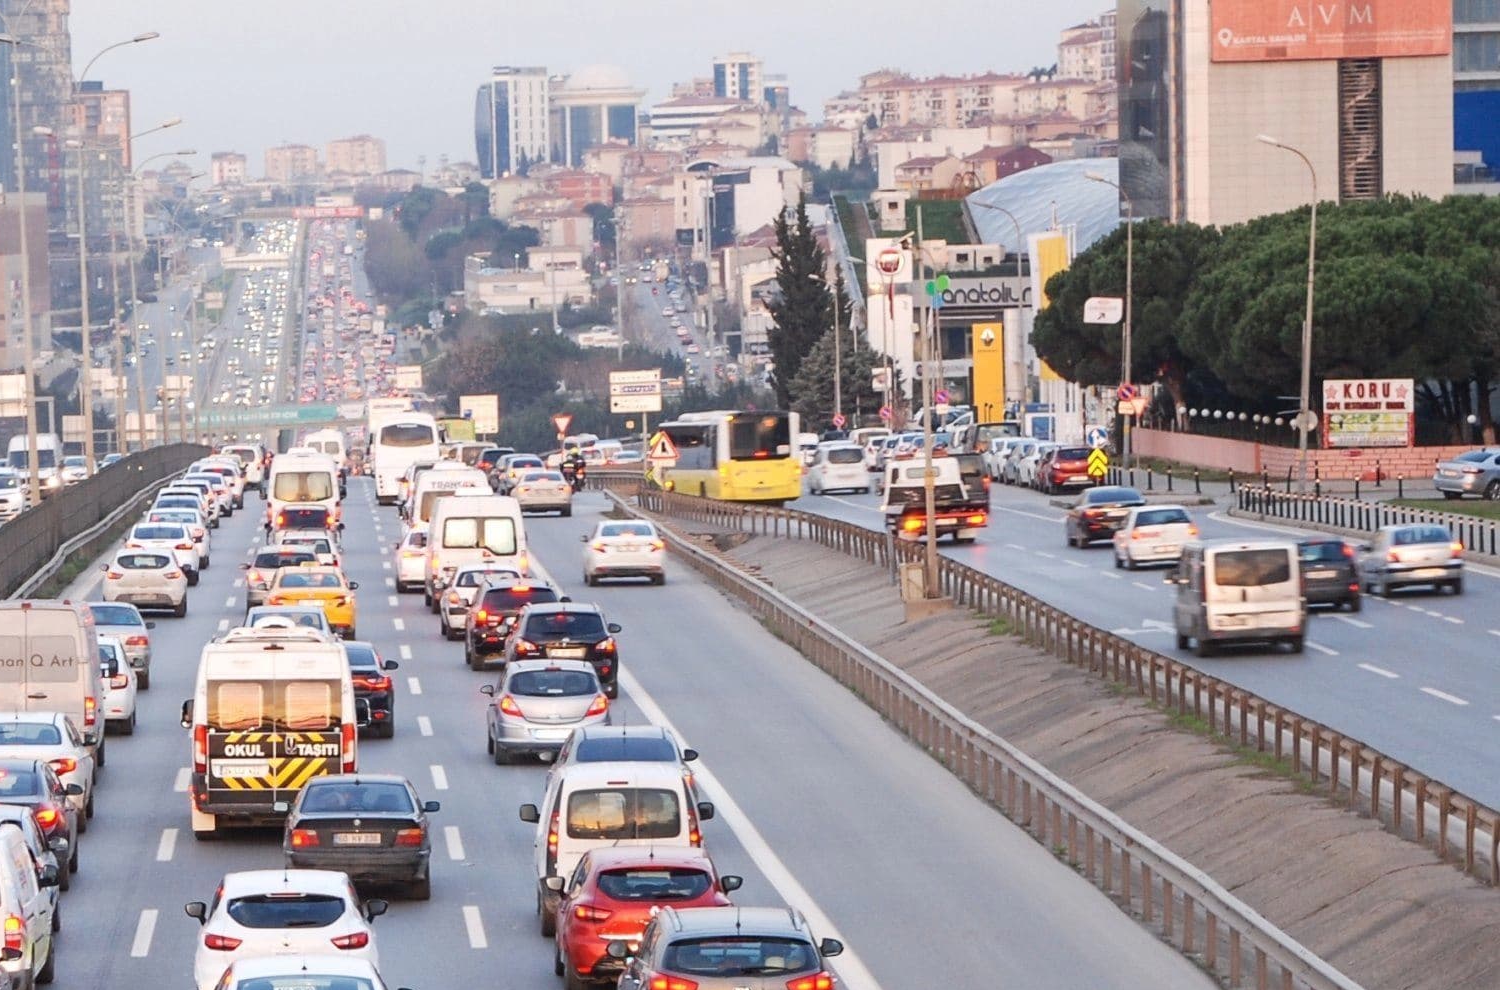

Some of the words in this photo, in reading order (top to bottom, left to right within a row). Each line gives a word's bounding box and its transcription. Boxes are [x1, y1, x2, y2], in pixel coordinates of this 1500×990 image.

[1343, 382, 1390, 398] KORU
[30, 654, 44, 667] Q
[50, 655, 73, 667] Art
[224, 744, 265, 757] OKUL
